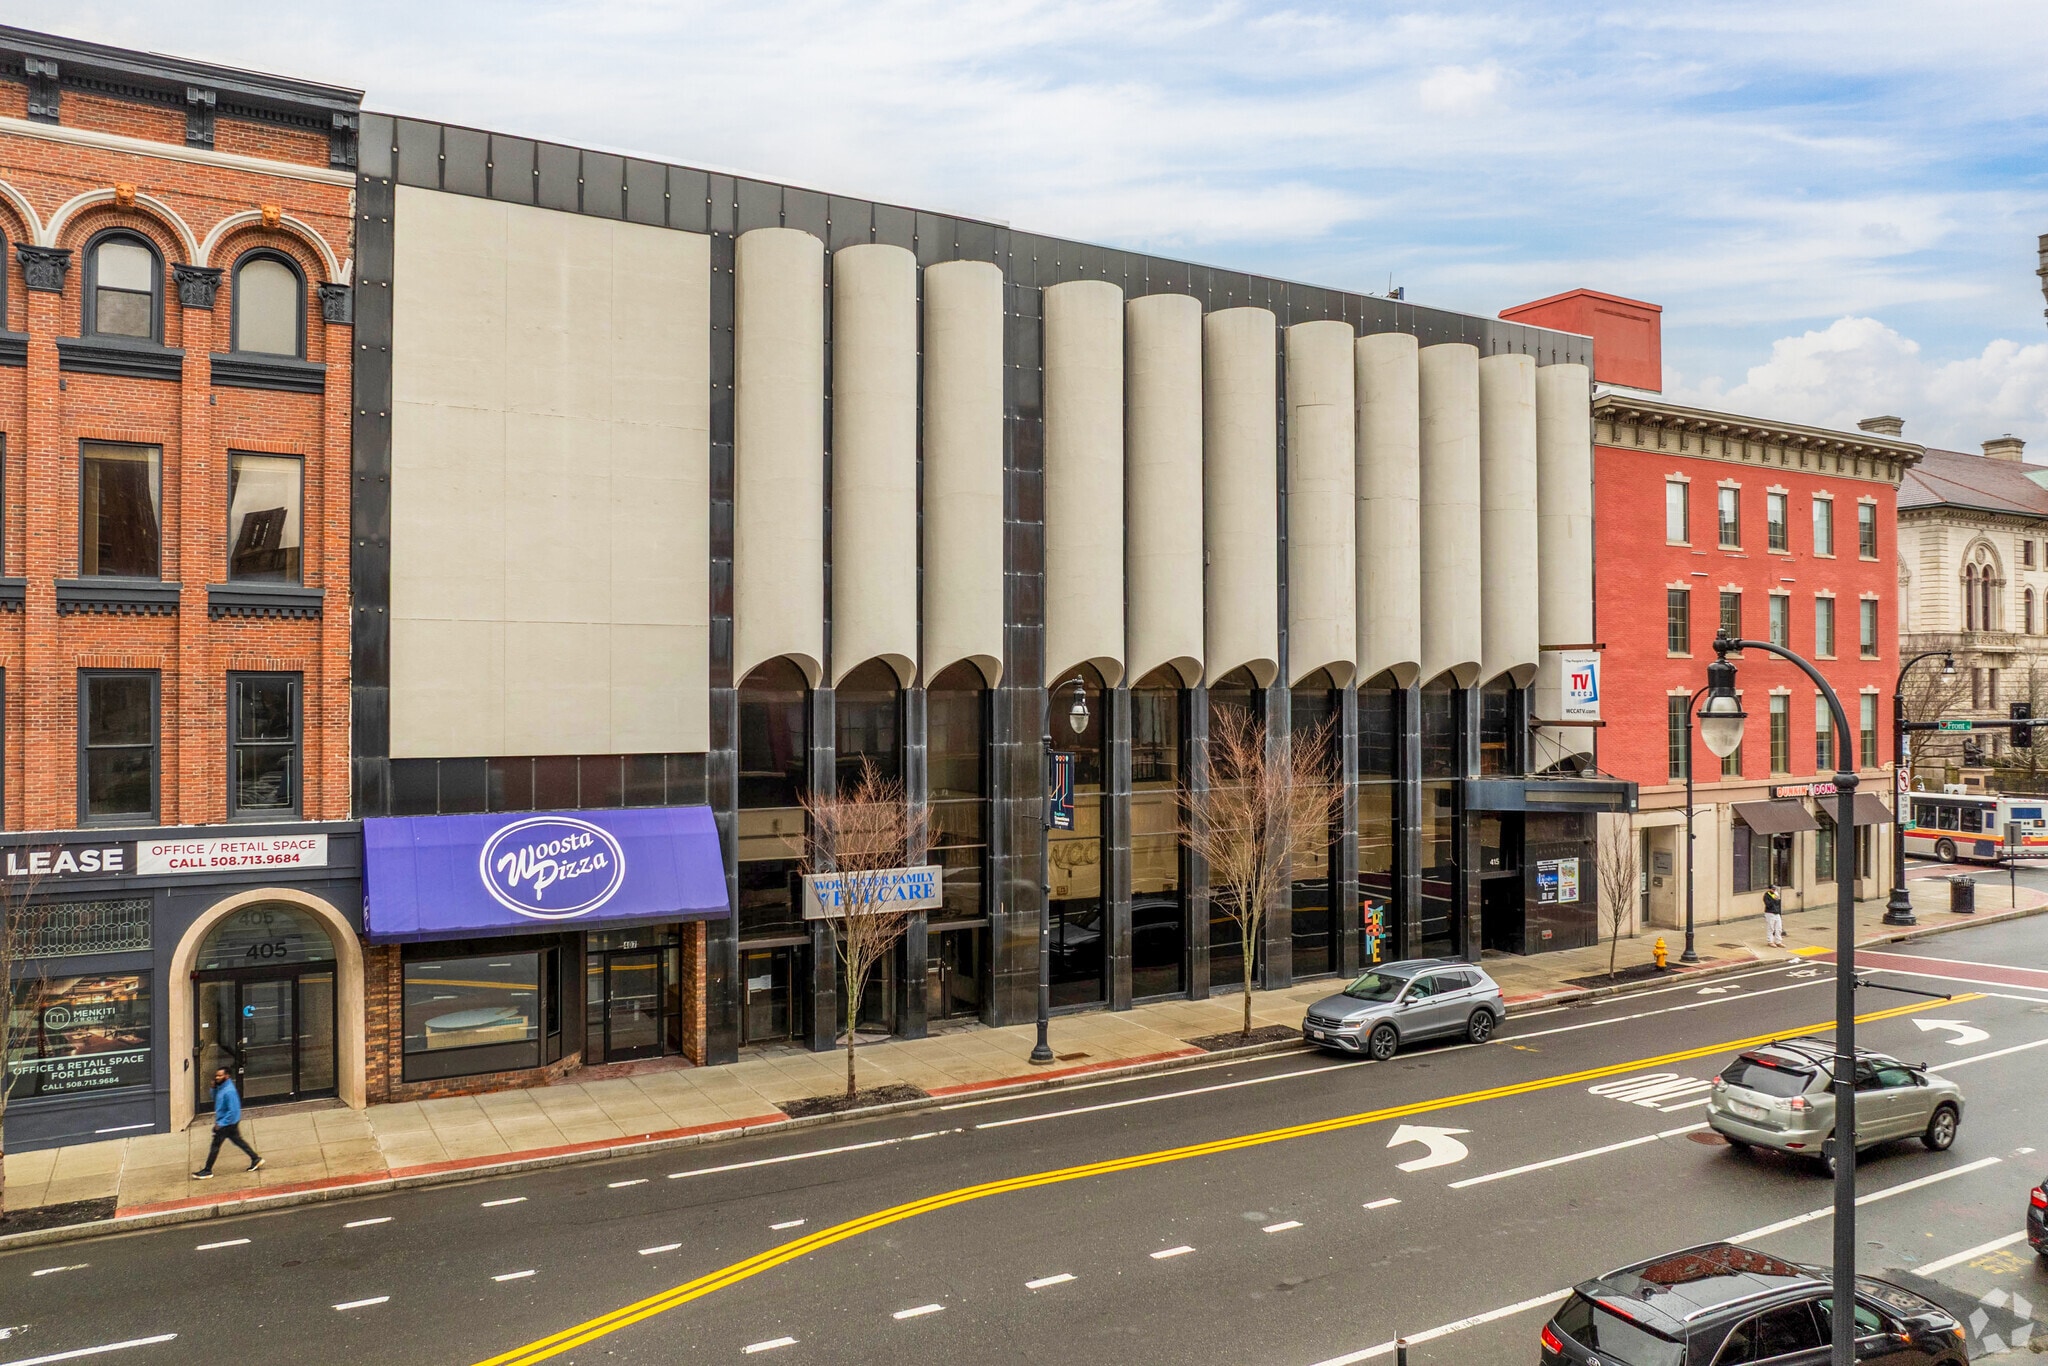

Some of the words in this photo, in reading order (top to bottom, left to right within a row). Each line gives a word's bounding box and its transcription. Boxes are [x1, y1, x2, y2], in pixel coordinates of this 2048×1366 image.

[1571, 673, 1589, 690] TV
[1947, 721, 1965, 730] Front
[1814, 782, 1837, 795] DONU
[152, 845, 205, 856] OFFICE
[221, 841, 268, 853] RETAIL
[273, 839, 316, 850] SPACE
[7, 848, 124, 876] LEASE
[169, 858, 207, 869] CALL
[210, 853, 301, 867] 508.713.9684
[497, 832, 594, 887] Woosta
[533, 852, 608, 901] Pizza
[814, 875, 889, 890] WORESTER
[892, 872, 935, 885] FAMILY
[246, 942, 288, 959] 405
[73, 1007, 116, 1018] MENKITI
[13, 1063, 54, 1075] OFFICE
[57, 1063, 65, 1071] &
[67, 1059, 107, 1070] RETAIL
[109, 1054, 145, 1066] SPACE
[51, 1070, 75, 1080] FOR
[77, 1066, 112, 1077] LEASE
[42, 1083, 64, 1091] CALL
[66, 1077, 120, 1088] 508.713.9684
